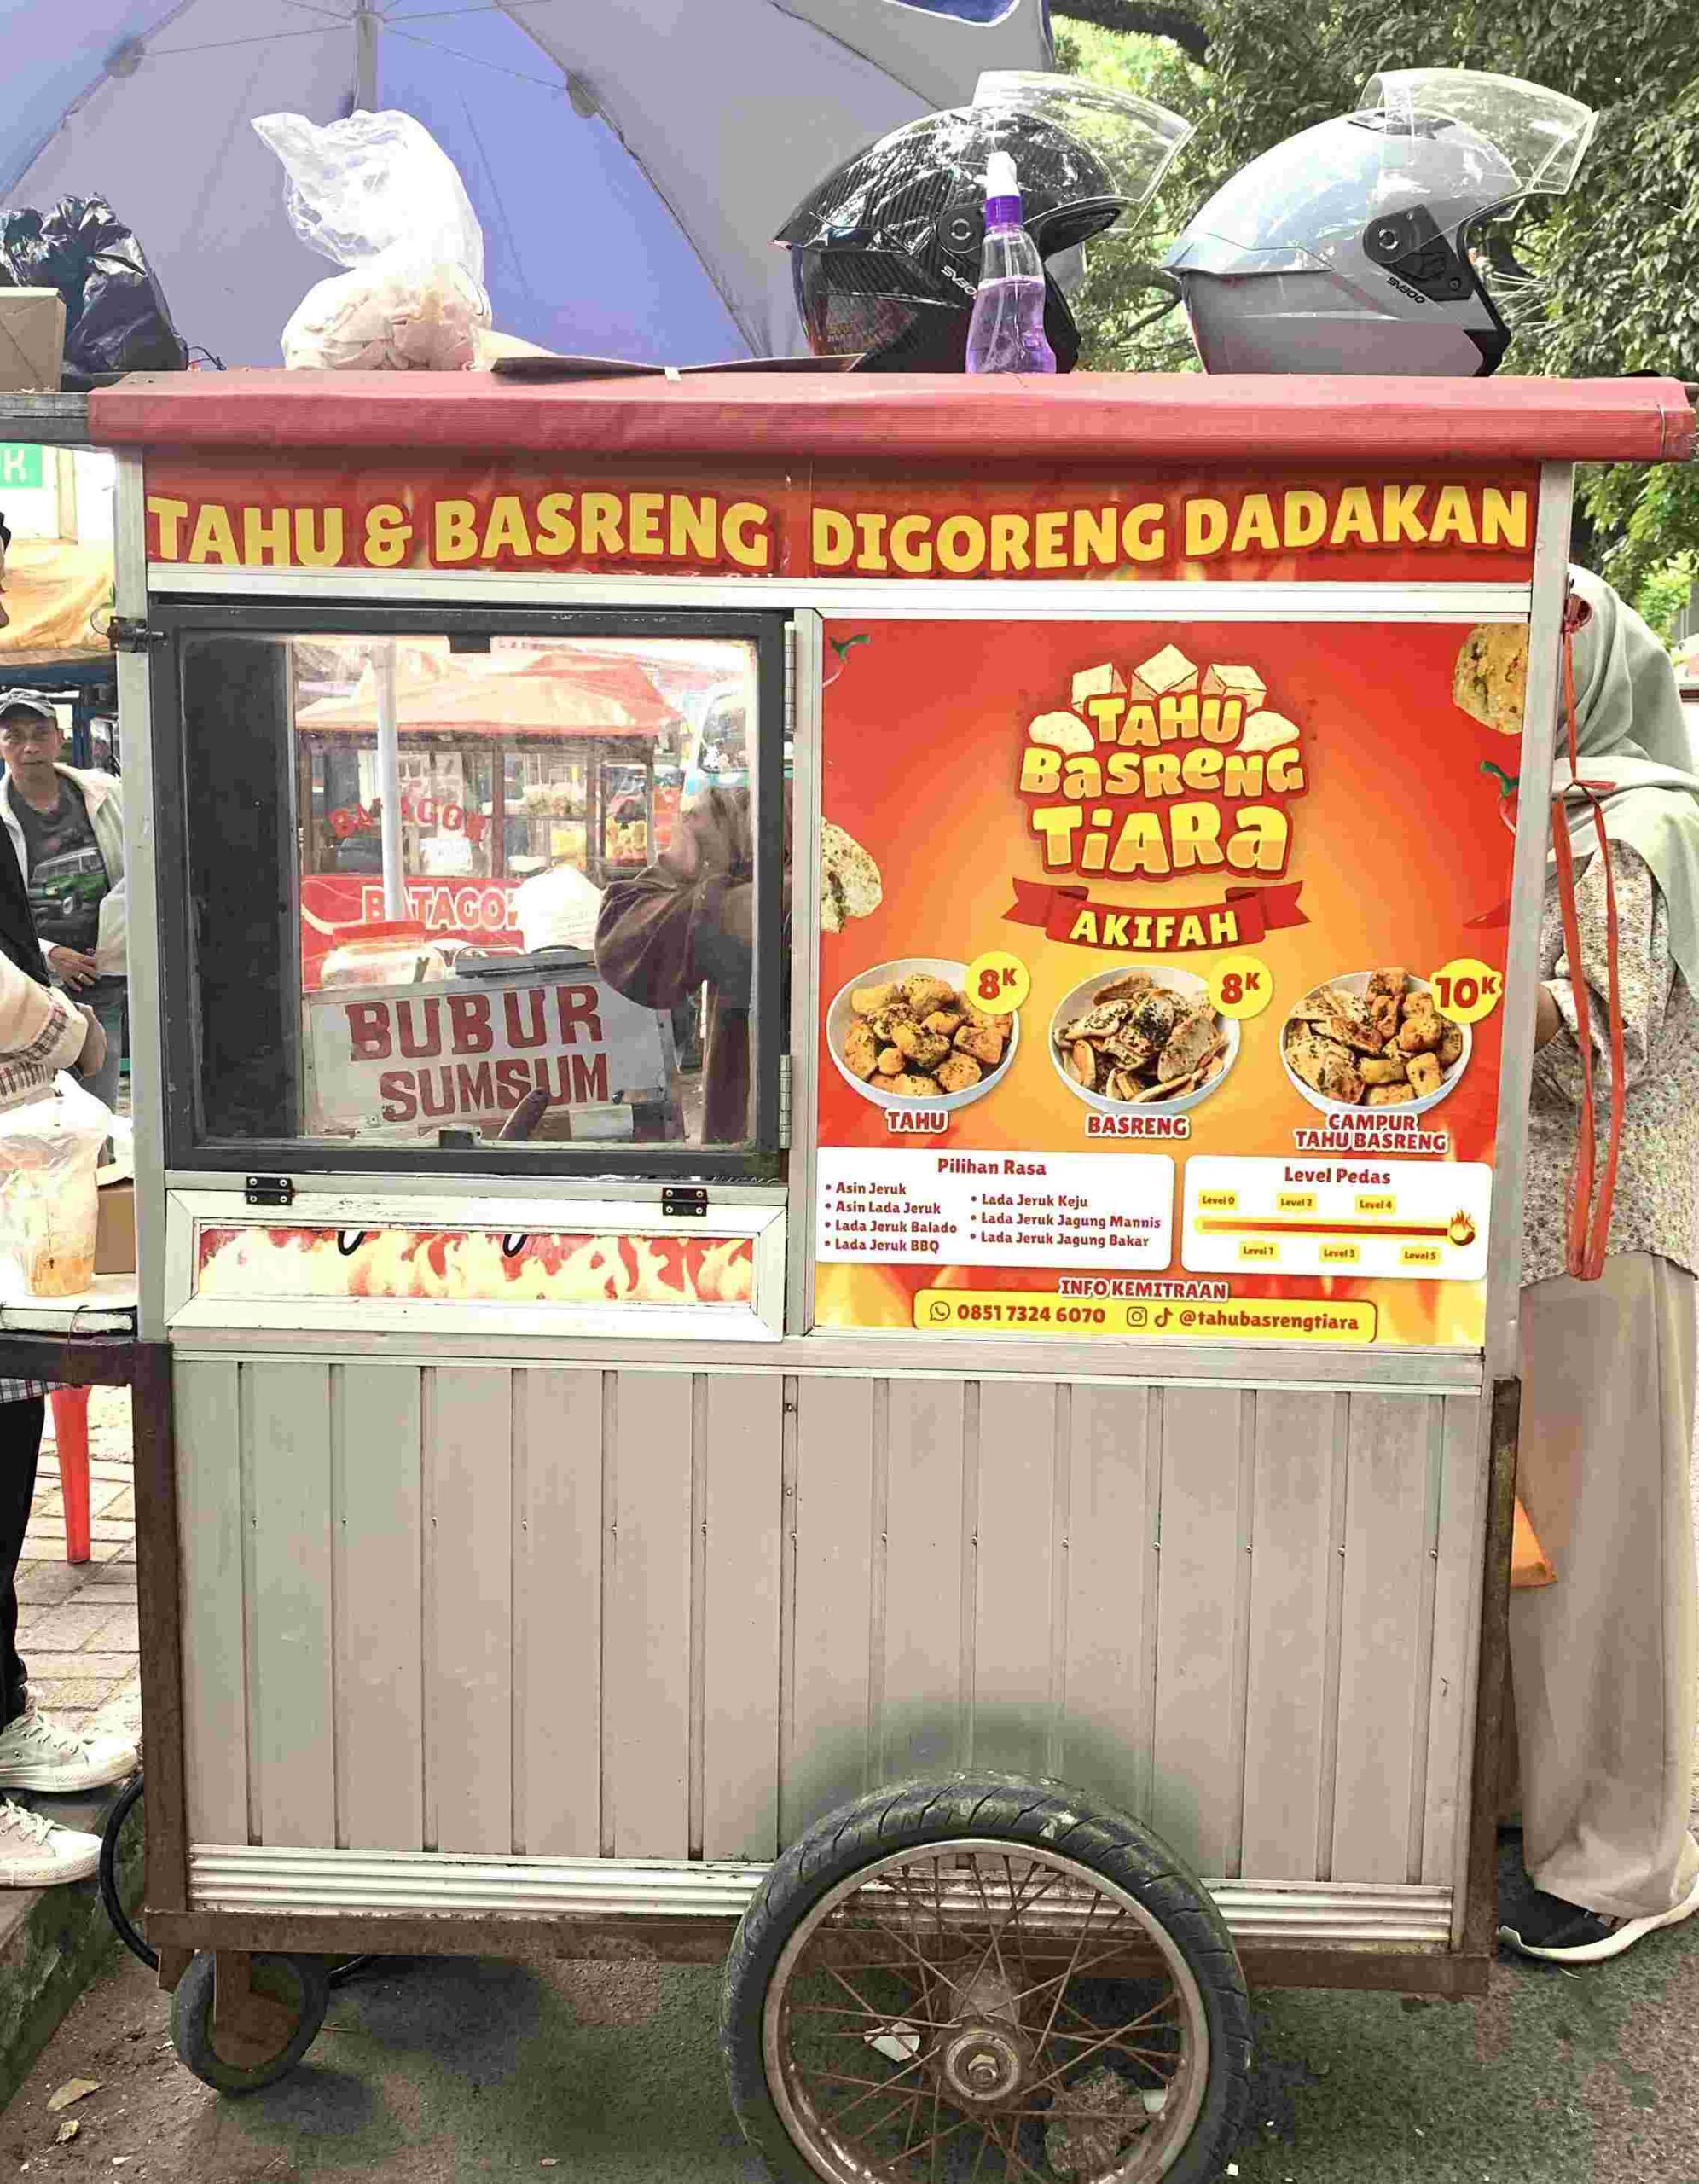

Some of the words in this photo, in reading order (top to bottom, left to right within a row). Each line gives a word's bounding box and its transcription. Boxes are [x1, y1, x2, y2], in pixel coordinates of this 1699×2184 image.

[941, 264, 977, 299] SV30
[148, 497, 342, 566] TAHU
[364, 503, 414, 566] &
[435, 493, 769, 567] BASRENG
[812, 502, 1166, 572] DIGORENG
[1185, 485, 1528, 555] DADAKAN
[1088, 694, 1242, 746] TAHU
[362, 886, 519, 931] BTAGO
[1069, 911, 1238, 948] AKIFAH
[1435, 977, 1497, 1008] 10K
[345, 984, 603, 1061] BUBUR
[380, 1053, 608, 1122] SUMSUM
[888, 1111, 946, 1130] TAHU
[1088, 1116, 1186, 1136] BASRENG
[1329, 1113, 1415, 1130] CAMPUR
[1296, 1130, 1349, 1148] TAHU
[1354, 1132, 1446, 1150] BASRENG
[938, 1158, 998, 1175] Pilihan
[1004, 1159, 1047, 1176] Rasa
[1285, 1166, 1331, 1182] Level
[1337, 1169, 1391, 1184] Pedas
[836, 1182, 866, 1194] Asin
[869, 1182, 907, 1194] Jeruk
[836, 1200, 865, 1212] Asin
[868, 1201, 900, 1213] Lada
[903, 1202, 941, 1214] Jeruk
[982, 1194, 1013, 1205] Lada
[1017, 1194, 1054, 1206] Jeruk
[1058, 1195, 1088, 1210] Keju
[1202, 1196, 1226, 1205] Level
[1281, 1198, 1304, 1206] Level
[1360, 1200, 1383, 1209] Level
[1386, 1200, 1392, 1209] 4
[835, 1219, 867, 1231] Lada
[870, 1220, 907, 1233] Jeruk
[911, 1222, 957, 1234] Balado
[981, 1212, 1012, 1224] Lada
[1016, 1213, 1053, 1225] Jeruk
[1058, 1214, 1106, 1229] Jagung
[1110, 1215, 1161, 1228] Mannis
[835, 1238, 867, 1250] Lada
[870, 1239, 907, 1251] Jeruk
[911, 1240, 940, 1254] BBQ
[981, 1231, 1012, 1243] Lada
[1016, 1232, 1052, 1245] Jeruk
[1057, 1233, 1105, 1248] Jagung
[1110, 1234, 1149, 1247] Bakar
[1244, 1246, 1267, 1255] Level
[1324, 1248, 1348, 1258] Level
[1349, 1249, 1355, 1258] 3
[1405, 1251, 1429, 1260] Level
[1430, 1252, 1436, 1260] 5
[1061, 1279, 1107, 1295] INFO
[1112, 1281, 1226, 1299] KEMITRAAN
[957, 1304, 1001, 1321] 0851
[1007, 1306, 1051, 1322] 7324
[1056, 1307, 1105, 1323] 6070
[1180, 1310, 1359, 1332] @tahubasrengtiara
